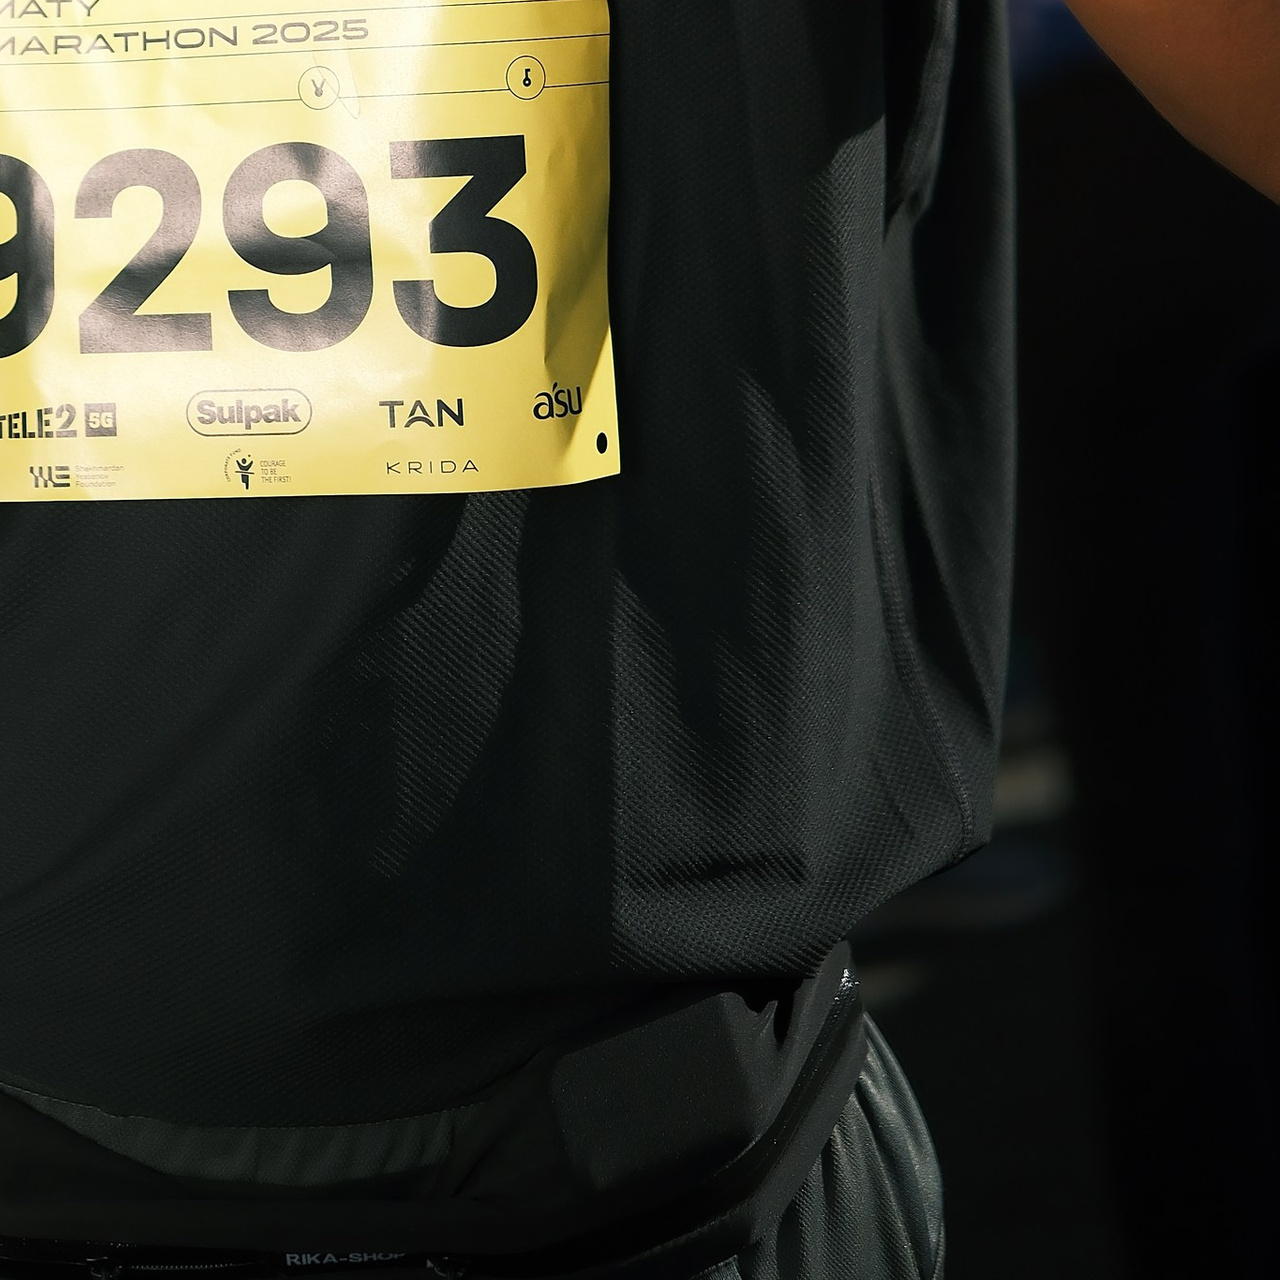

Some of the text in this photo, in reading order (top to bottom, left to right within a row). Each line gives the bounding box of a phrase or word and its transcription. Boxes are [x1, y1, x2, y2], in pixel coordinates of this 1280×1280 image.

[252, 18, 369, 45] 2025
[88, 412, 114, 429] 5G
[197, 398, 302, 430] Sulpak
[379, 398, 465, 428] TAN
[386, 460, 479, 475] KRIDA
